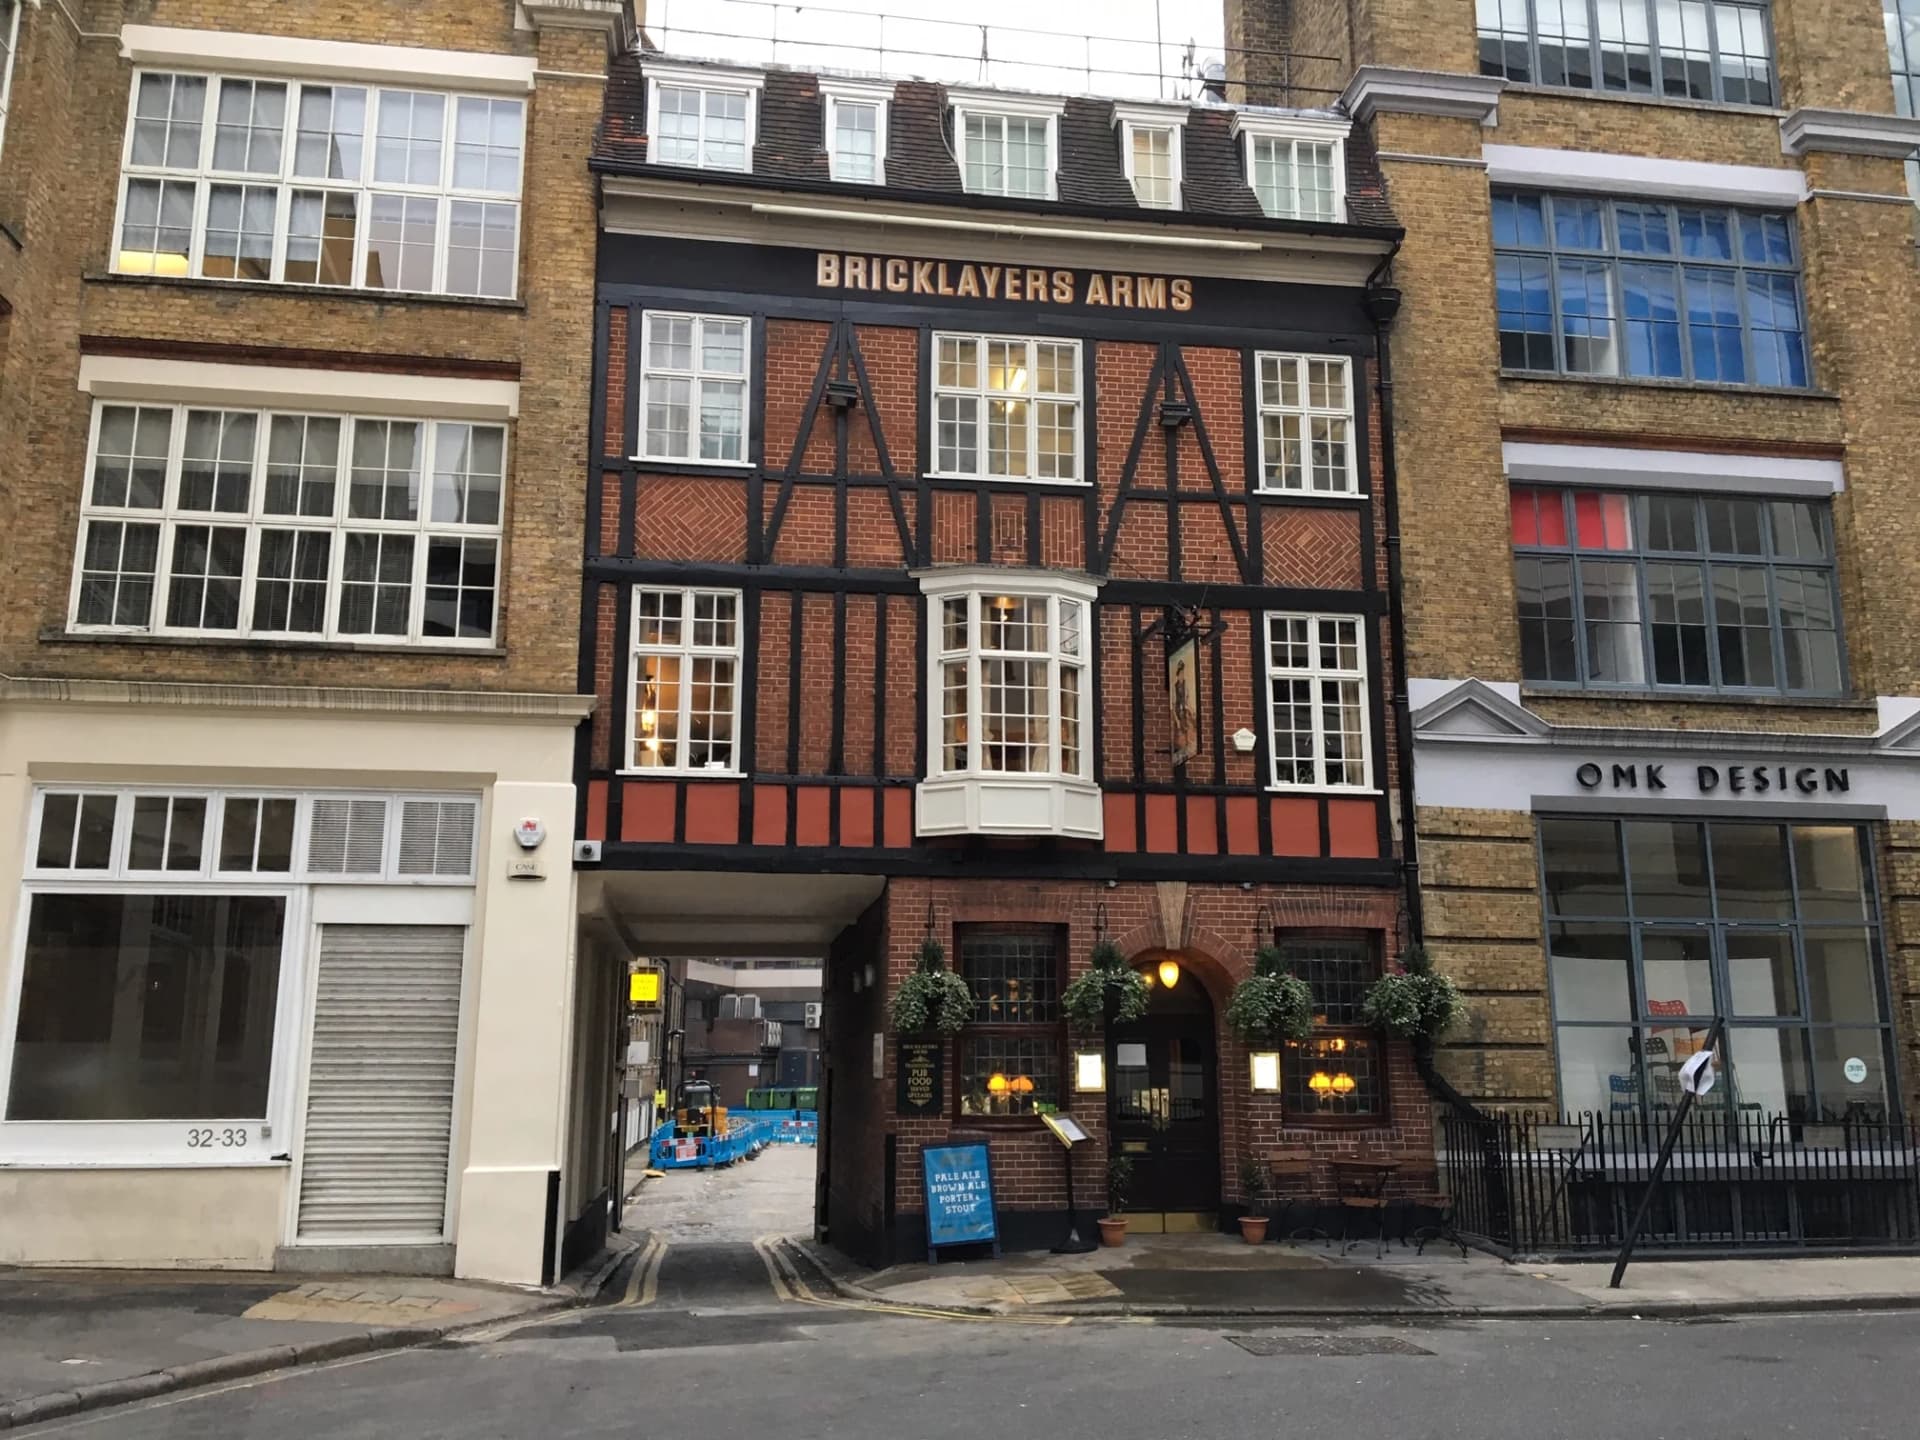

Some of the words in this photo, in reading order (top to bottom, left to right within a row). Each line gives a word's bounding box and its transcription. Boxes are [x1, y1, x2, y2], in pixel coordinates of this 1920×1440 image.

[816, 252, 1075, 304] BRICKLAYERS
[1084, 273, 1194, 312] ARMS
[1575, 761, 1668, 790] OMK
[1696, 764, 1850, 794] DESIGN
[911, 1068, 929, 1077] PUB
[907, 1077, 933, 1086] FOOD
[187, 1128, 248, 1148] 32-33
[934, 1171, 960, 1183] PALE
[961, 1169, 981, 1181] ALE
[930, 1183, 965, 1194] BROWN
[967, 1180, 987, 1191] ALE
[939, 1192, 974, 1204] PORTER
[945, 1203, 977, 1215] STOUT
